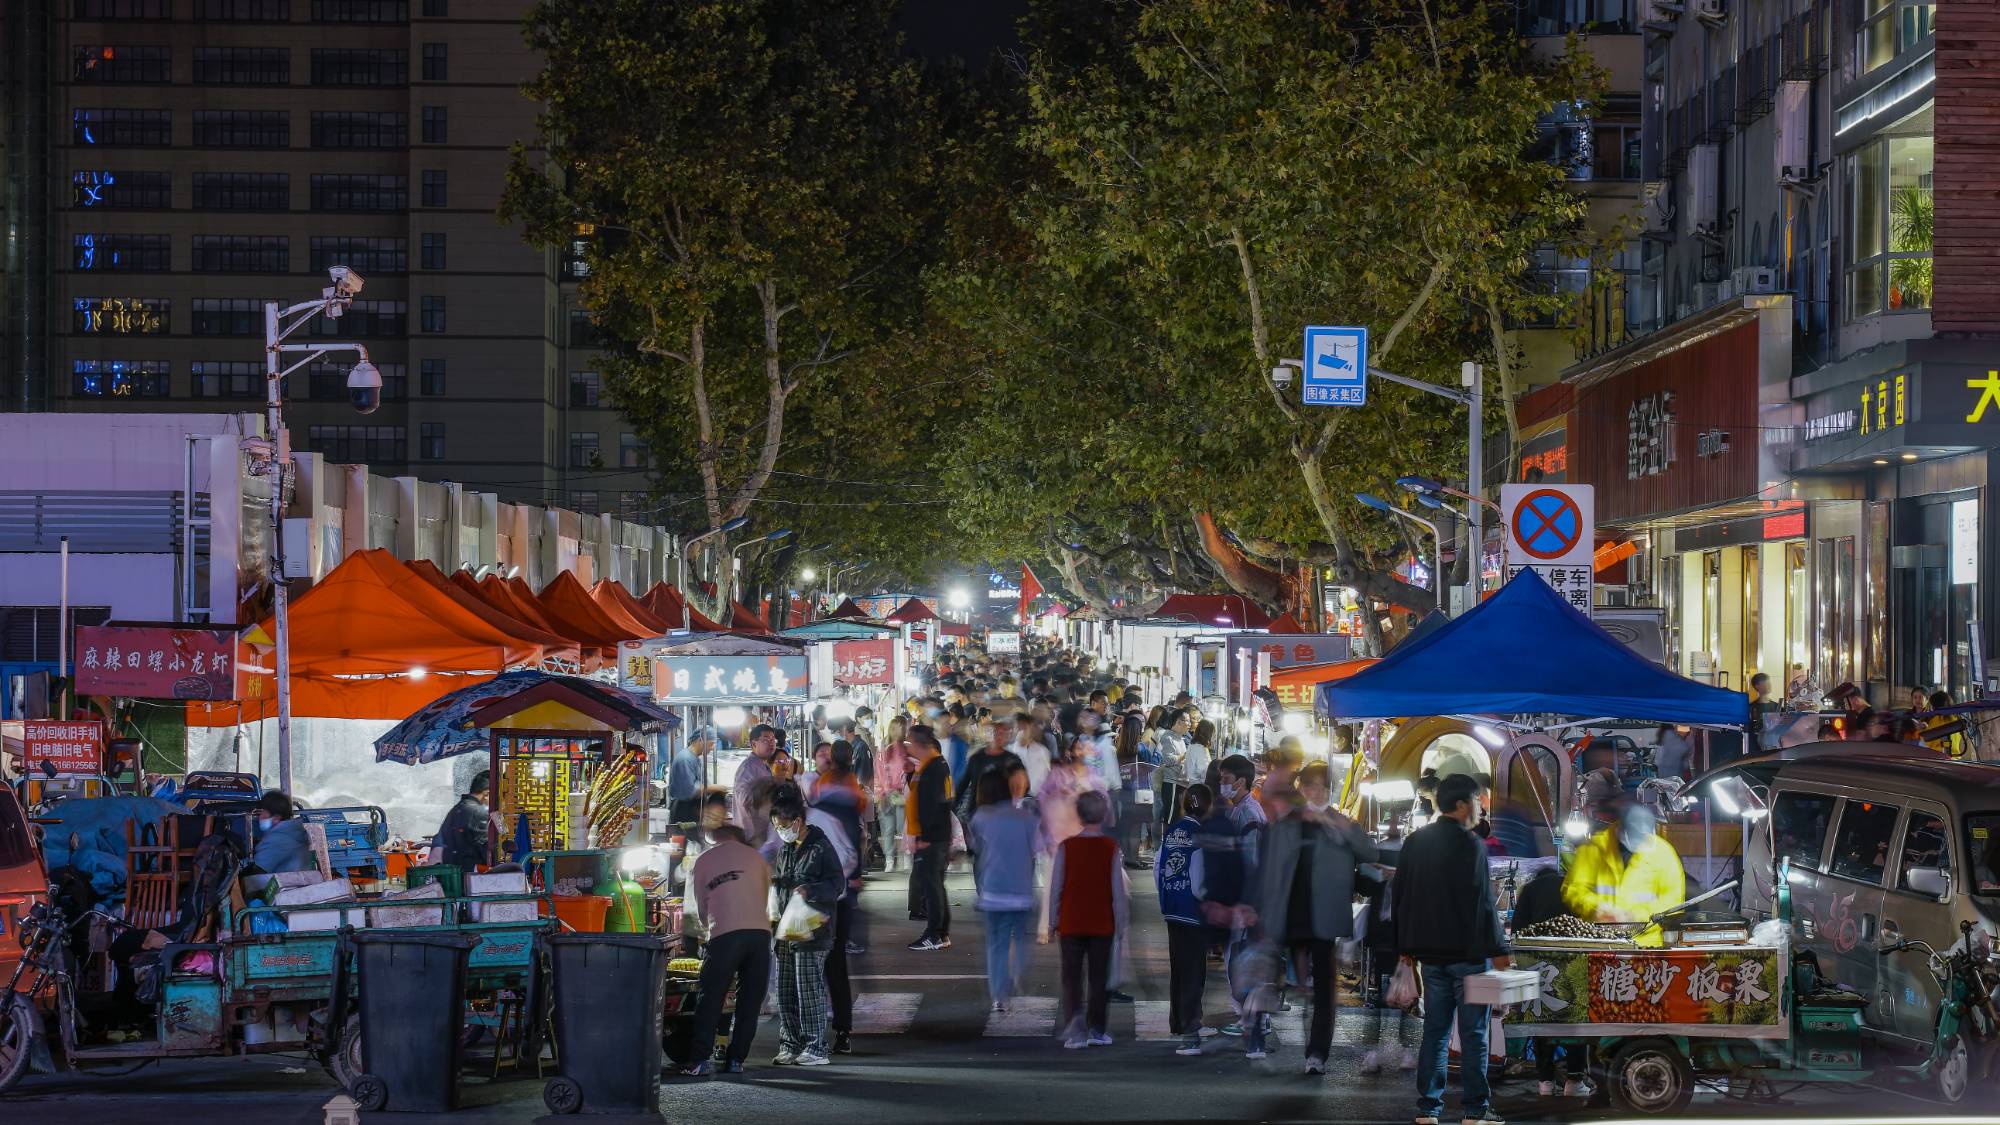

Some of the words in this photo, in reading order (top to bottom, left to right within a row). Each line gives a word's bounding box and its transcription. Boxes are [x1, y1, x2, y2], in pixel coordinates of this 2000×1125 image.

[1307, 387, 1362, 401] 图像采集区
[81, 645, 229, 675] 麻辣田螺小龙虾
[1260, 643, 1317, 662] 特色
[26, 725, 98, 740] 高价回收旧手机
[32, 742, 93, 758] 旧电脑旧电气
[1600, 959, 1770, 1005] 糖炒板栗
